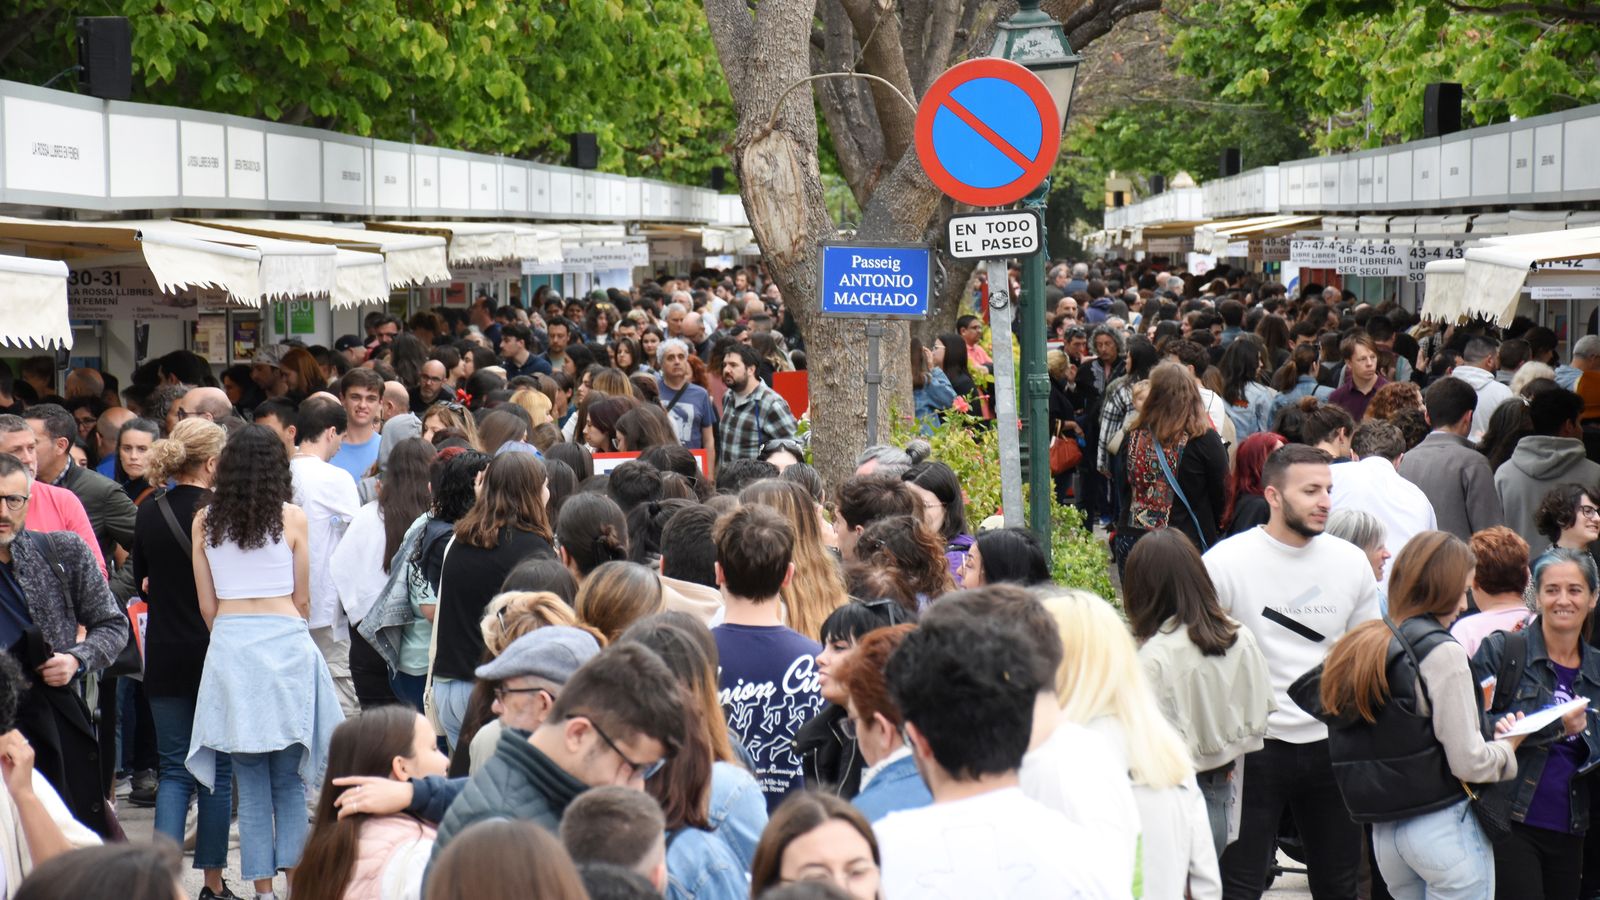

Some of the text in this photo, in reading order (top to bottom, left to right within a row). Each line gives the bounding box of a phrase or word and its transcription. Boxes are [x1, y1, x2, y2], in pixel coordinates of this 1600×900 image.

[955, 219, 1030, 236] EN TODO
[954, 236, 1033, 253] EL PASEO
[1360, 245, 1396, 255] 45-46
[851, 254, 901, 271] Passeig
[1360, 257, 1403, 266] LIBRERÍA
[69, 270, 121, 286] 30-31
[1360, 267, 1389, 276] SEGUÍ
[838, 273, 913, 288] ANTONIO
[82, 288, 114, 296] ROSSA
[116, 288, 154, 297] LLIBRES
[833, 291, 918, 307] MACHADO
[83, 297, 118, 305] FEMENÍ
[1314, 604, 1337, 614] KING
[717, 675, 777, 706] nion
